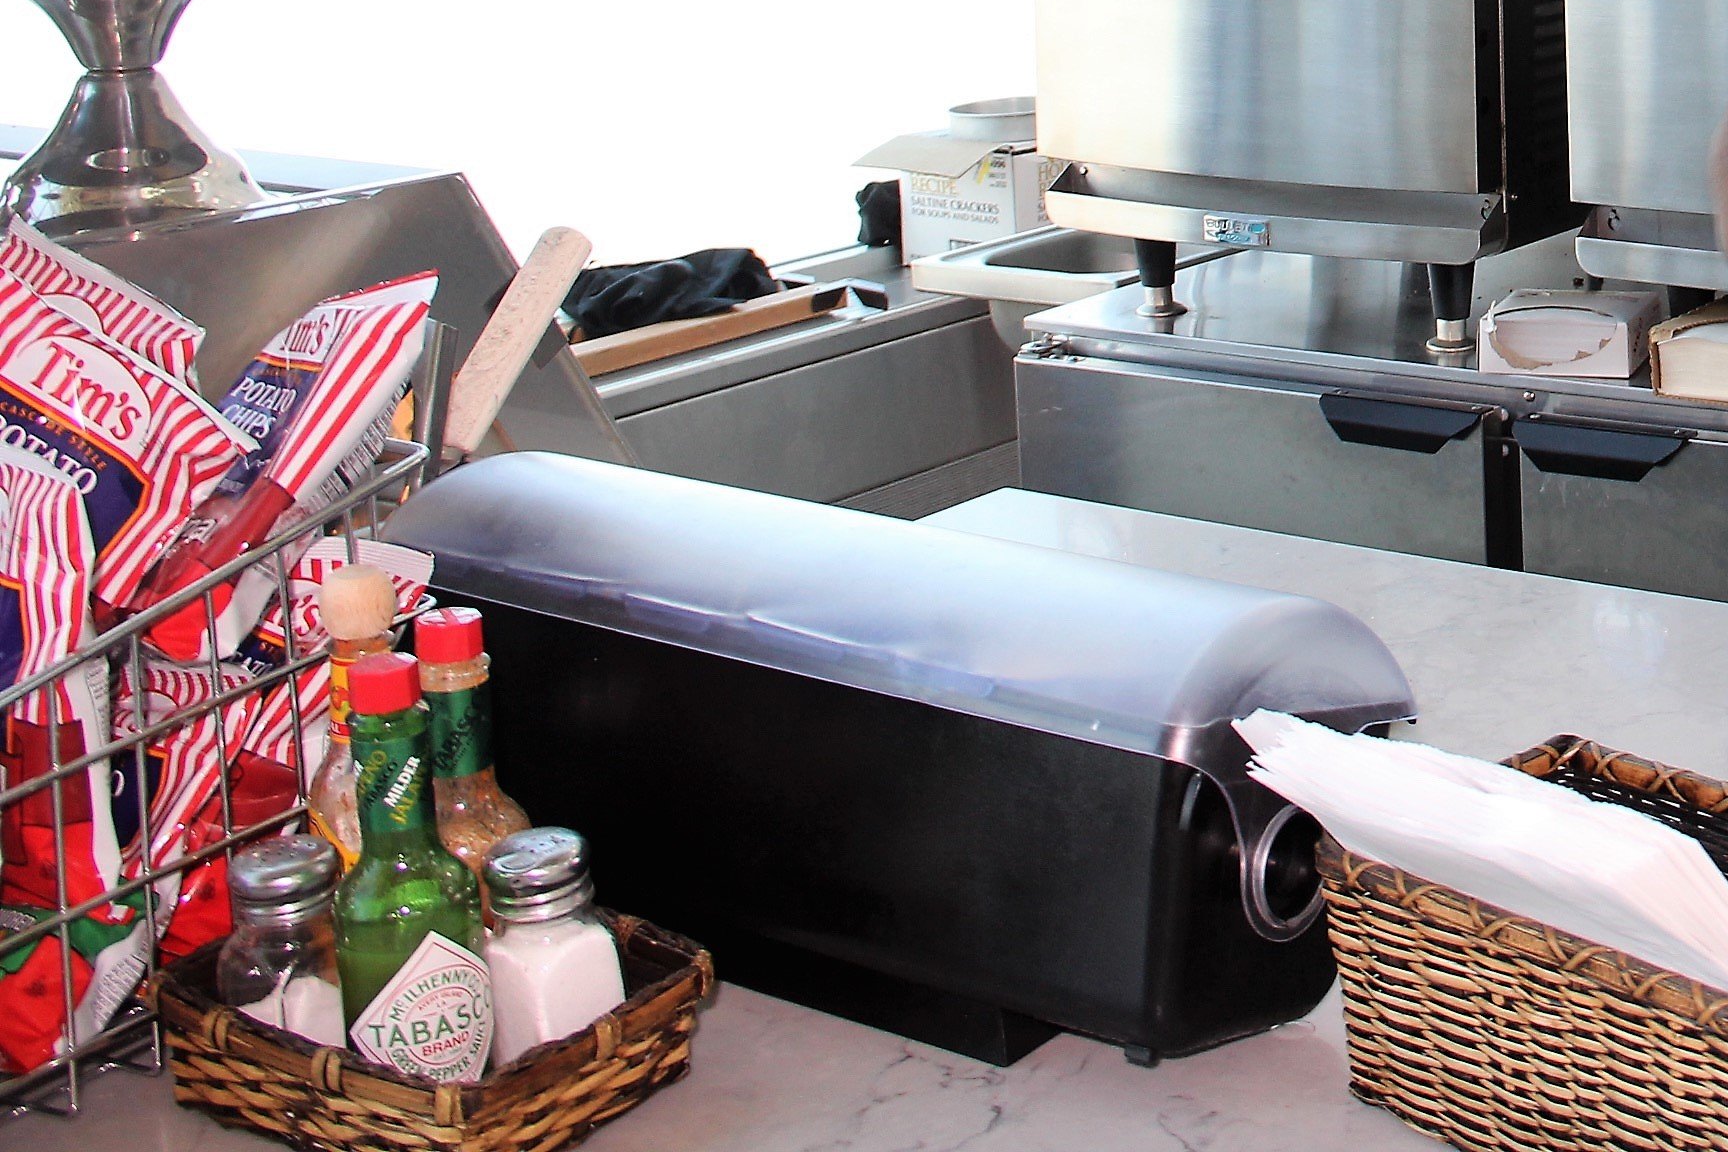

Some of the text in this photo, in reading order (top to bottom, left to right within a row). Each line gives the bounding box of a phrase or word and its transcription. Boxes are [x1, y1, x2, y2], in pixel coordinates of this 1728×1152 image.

[911, 175, 958, 195] RECIPE
[911, 195, 1000, 214] SALTINE CRACKERS
[952, 211, 969, 221] AND
[970, 213, 1000, 224] SALADS
[30, 341, 142, 440] Tim's
[230, 376, 298, 414] POTATO
[0, 400, 67, 437] CASCDE
[221, 403, 277, 440] CHIPS
[383, 755, 421, 808] MILDER
[421, 1030, 470, 1057] BRAND
[427, 1055, 471, 1081] PEPPER
